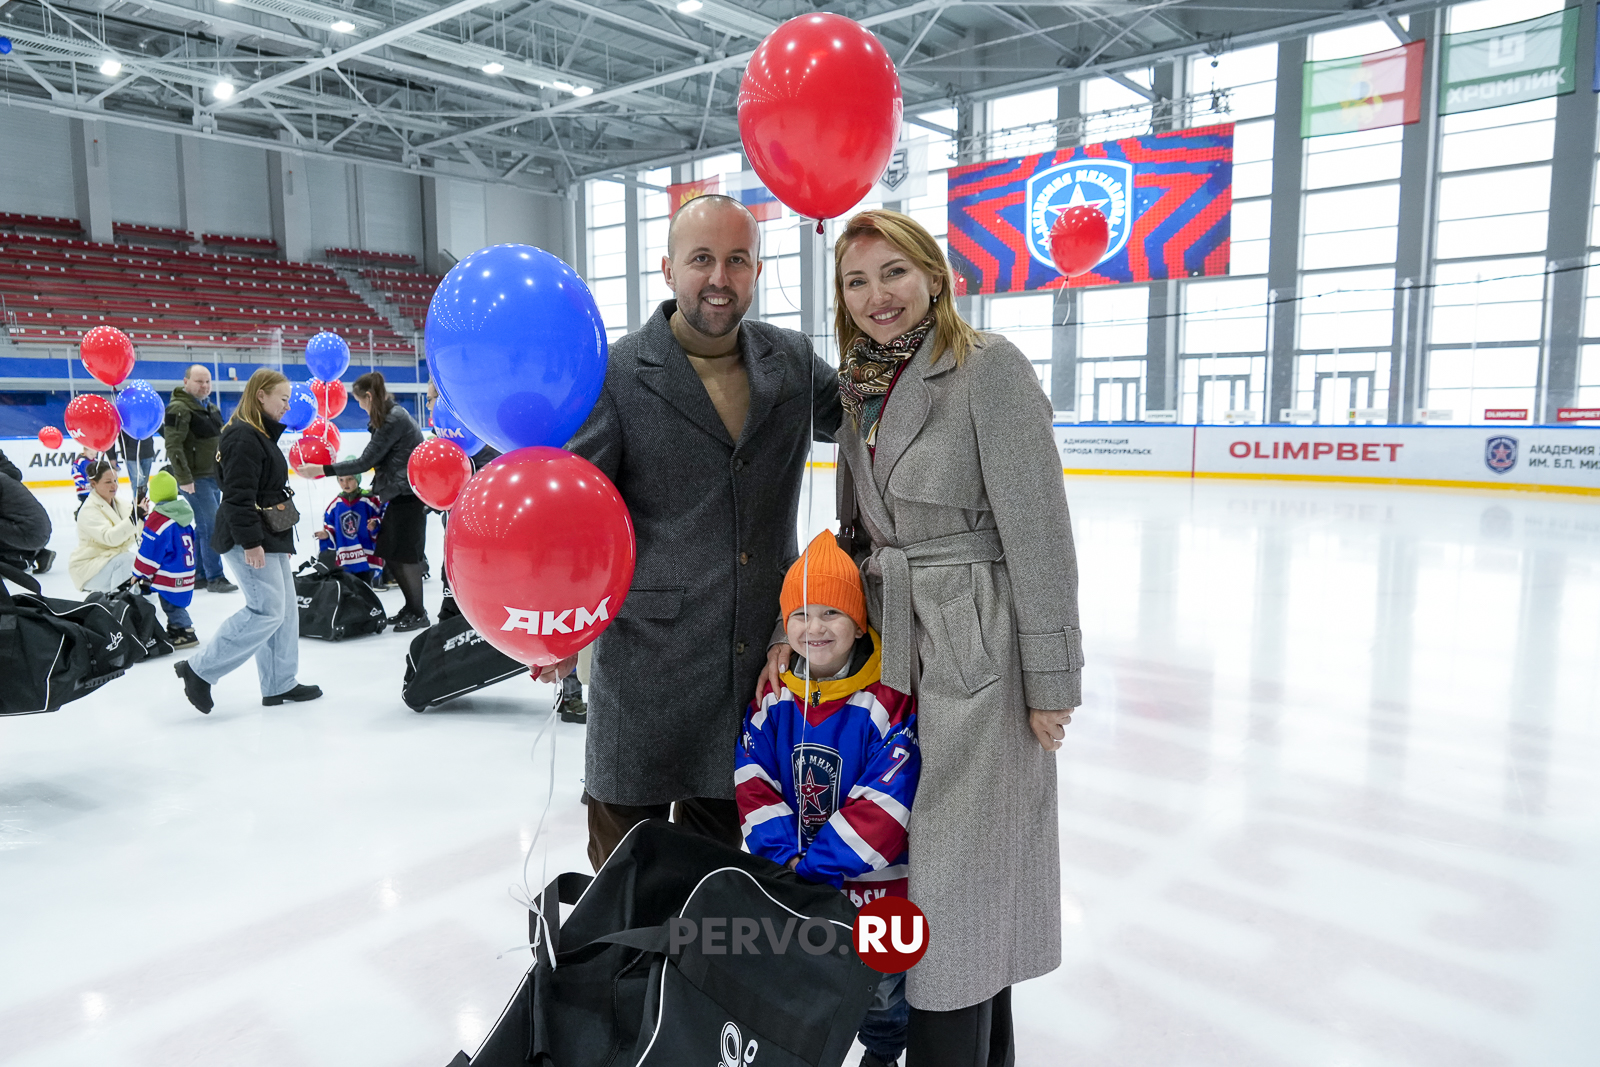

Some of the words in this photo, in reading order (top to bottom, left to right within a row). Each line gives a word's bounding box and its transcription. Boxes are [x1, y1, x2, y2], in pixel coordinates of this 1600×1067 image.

[1447, 67, 1566, 105] ХРОМПИК
[1229, 441, 1404, 462] OLIMPBET
[1529, 445, 1595, 456] АКАДЕМИЯ
[1529, 458, 1550, 468] ИМ.
[1554, 459, 1575, 469] Б.П.
[1580, 459, 1600, 470] МИ
[500, 595, 612, 636] AKM
[881, 746, 911, 783] 7
